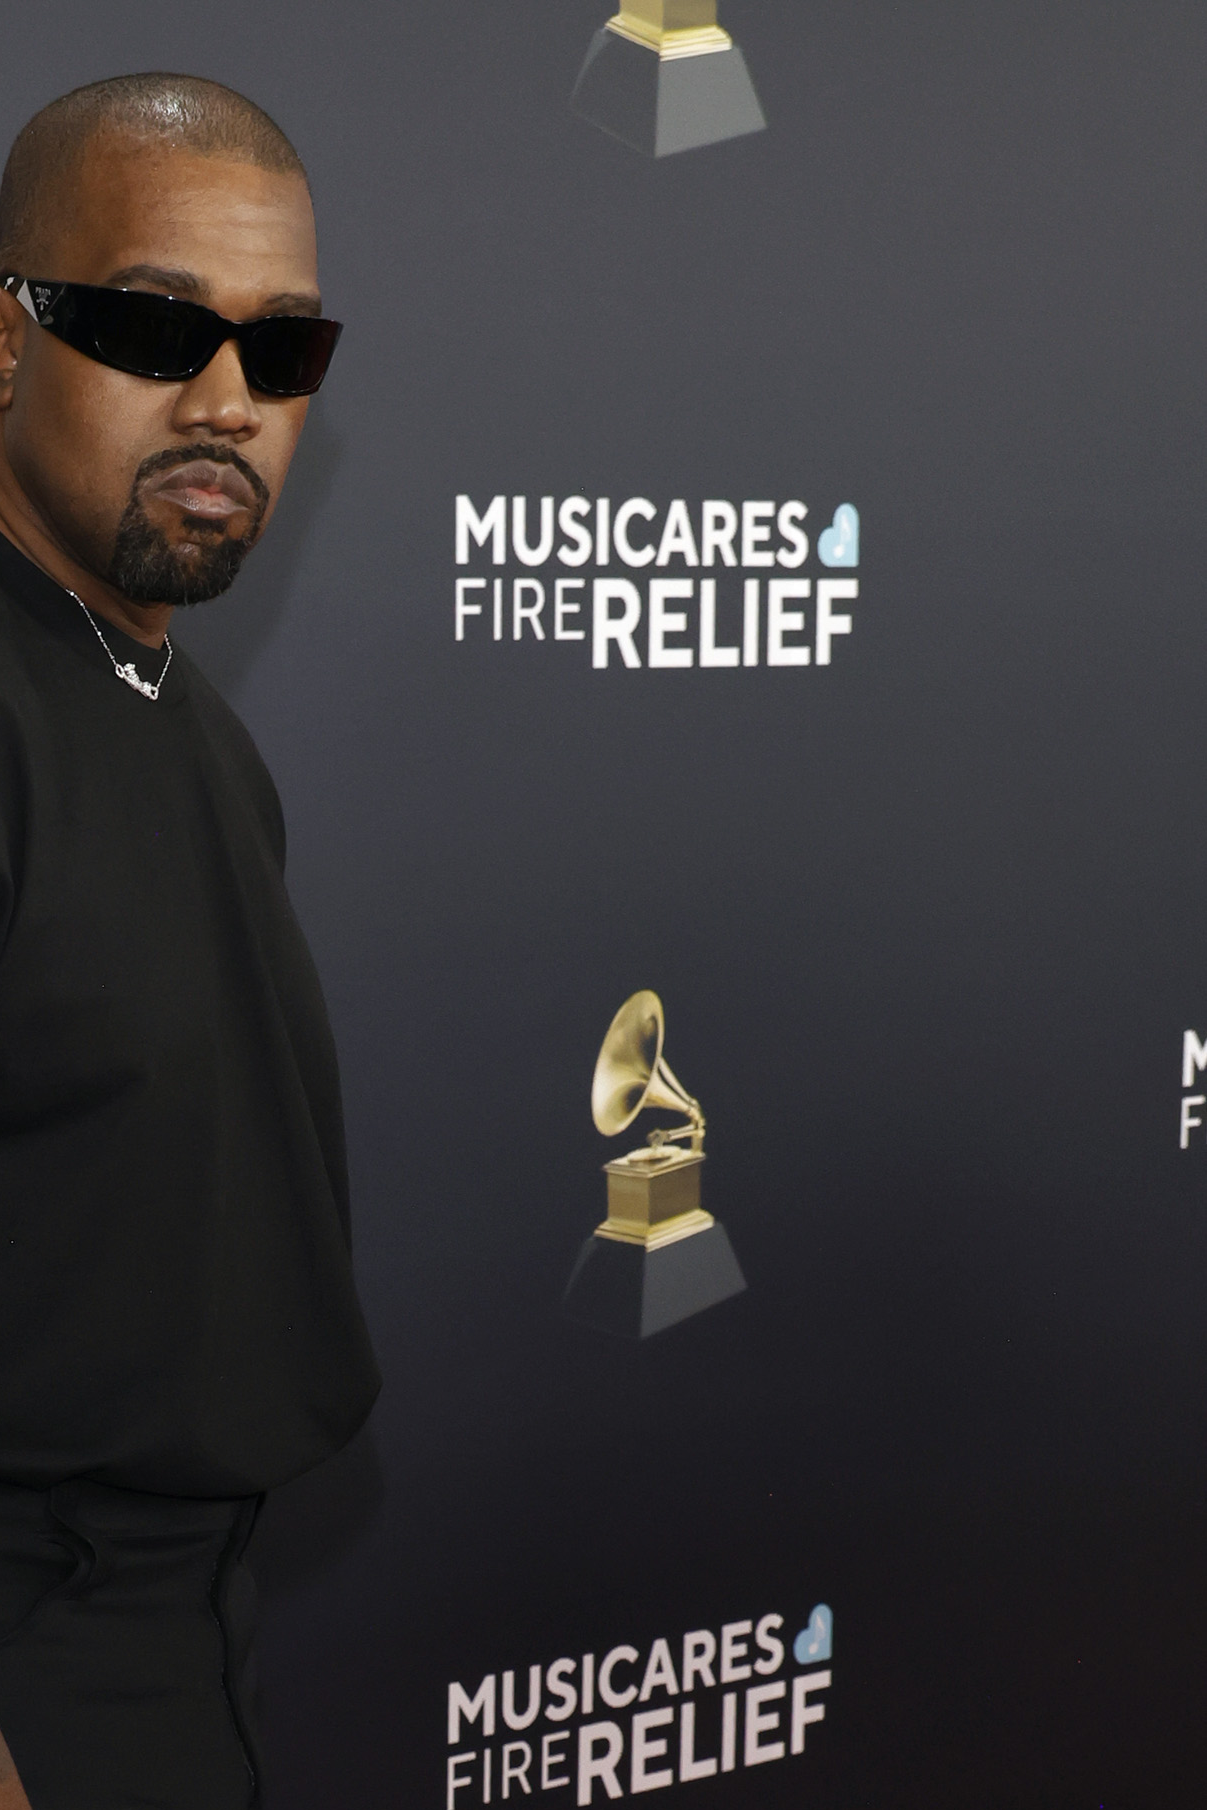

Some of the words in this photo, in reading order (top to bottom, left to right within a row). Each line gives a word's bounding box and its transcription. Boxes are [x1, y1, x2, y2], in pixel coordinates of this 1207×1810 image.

[454, 494, 809, 569] MUSICARES
[454, 578, 586, 642] FIRE
[591, 578, 860, 670] RELIEF
[447, 1613, 785, 1745] MUSICARES
[577, 1669, 832, 1807] RELIEF
